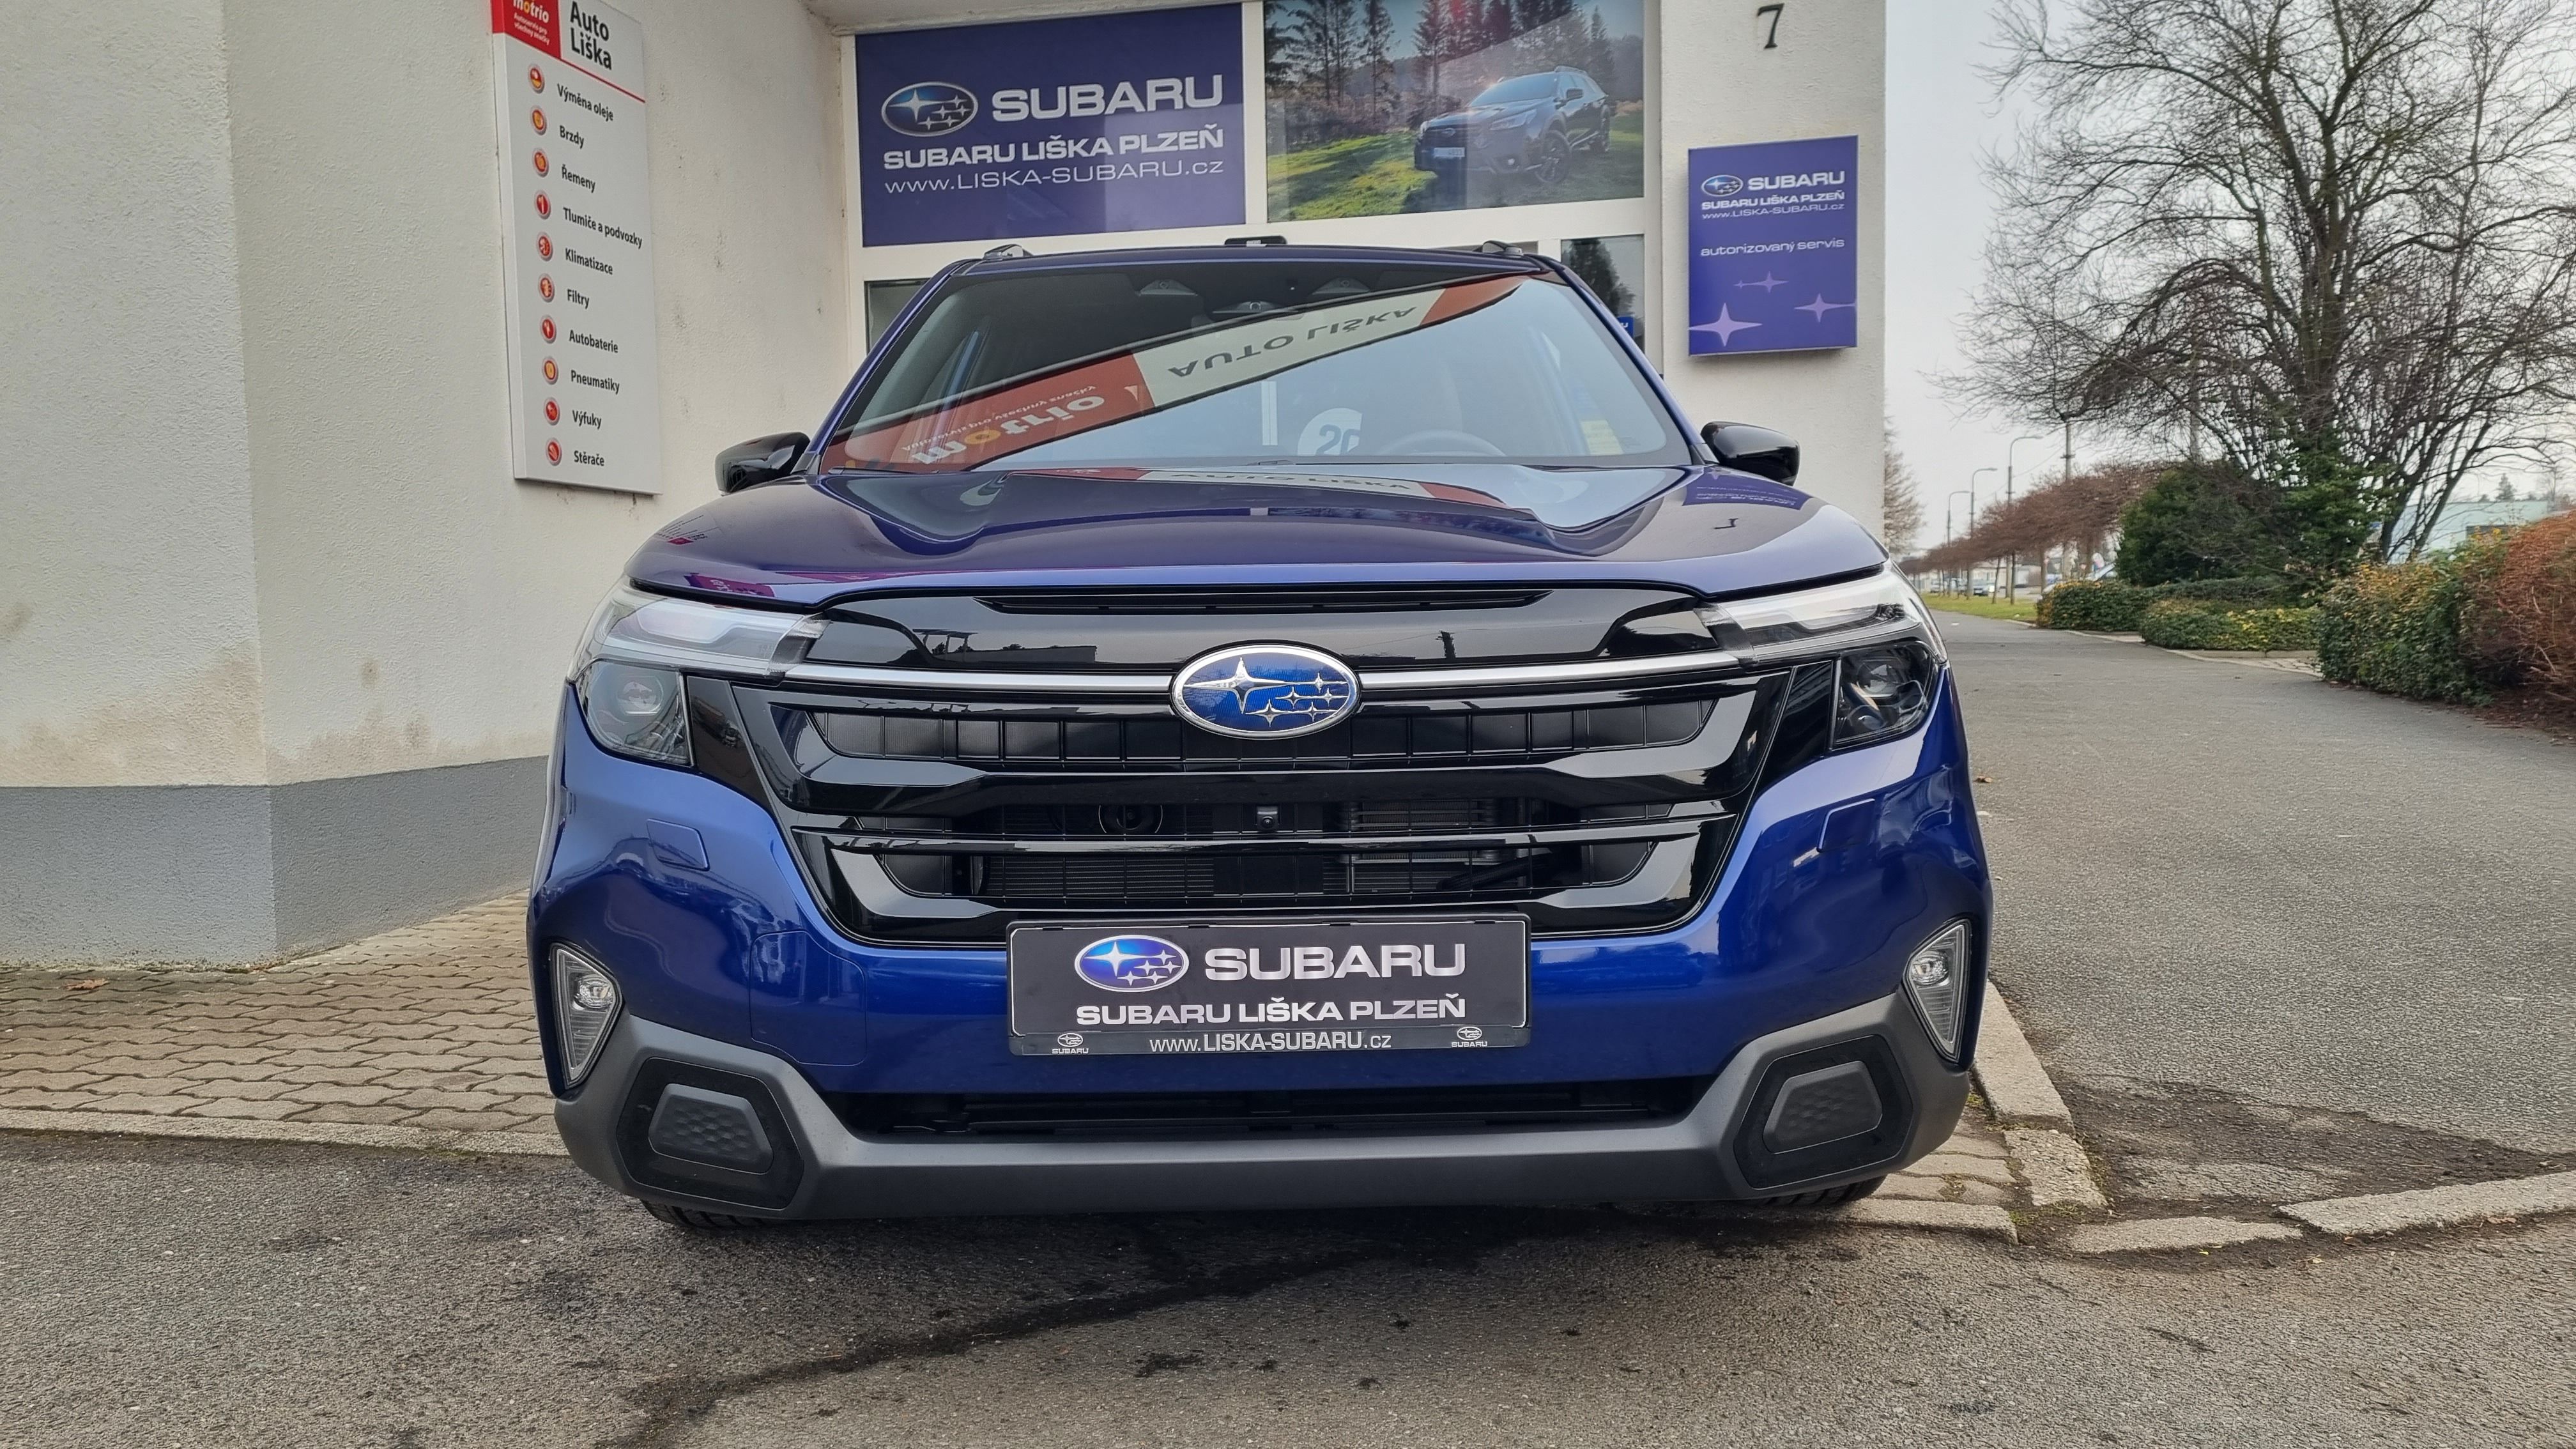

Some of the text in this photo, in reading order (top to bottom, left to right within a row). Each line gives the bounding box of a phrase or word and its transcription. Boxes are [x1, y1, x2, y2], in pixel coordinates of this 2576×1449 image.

[513, 0, 549, 24] motrio
[570, 1, 610, 42] Auto
[1757, 3, 1785, 49] 7
[570, 27, 612, 70] Liška
[557, 83, 614, 122] Výměna oleje
[992, 74, 1223, 123] SUBARU
[560, 125, 585, 149] Brzdy
[884, 123, 1224, 170] SUBARU LIŠKA PLZEŇ
[562, 164, 596, 193] Řemeny
[885, 160, 1224, 194] www.LISKA-SUBARU.cz
[1748, 171, 1845, 191] SUBARU
[1701, 190, 1845, 211] SUBARU LIŠKA PLZEŇ
[1702, 203, 1845, 219] www.LISKA-SUBARU.cz
[563, 207, 643, 250] Tlumiče a podvozky
[1701, 238, 1845, 256] autorizovaný servis
[565, 248, 613, 275] Klimatizace
[567, 289, 590, 309] Filtry
[569, 330, 618, 353] Autobaterie
[571, 370, 620, 395] Pneumatiky
[572, 410, 602, 430] Výfuky
[574, 450, 605, 466] Stěrače
[1204, 944, 1466, 981] SUBARU
[1077, 993, 1466, 1025] SUBARU LIŠKA PLZEŇ
[1149, 1031, 1392, 1053] www.LISKA-SUBARU.cz
